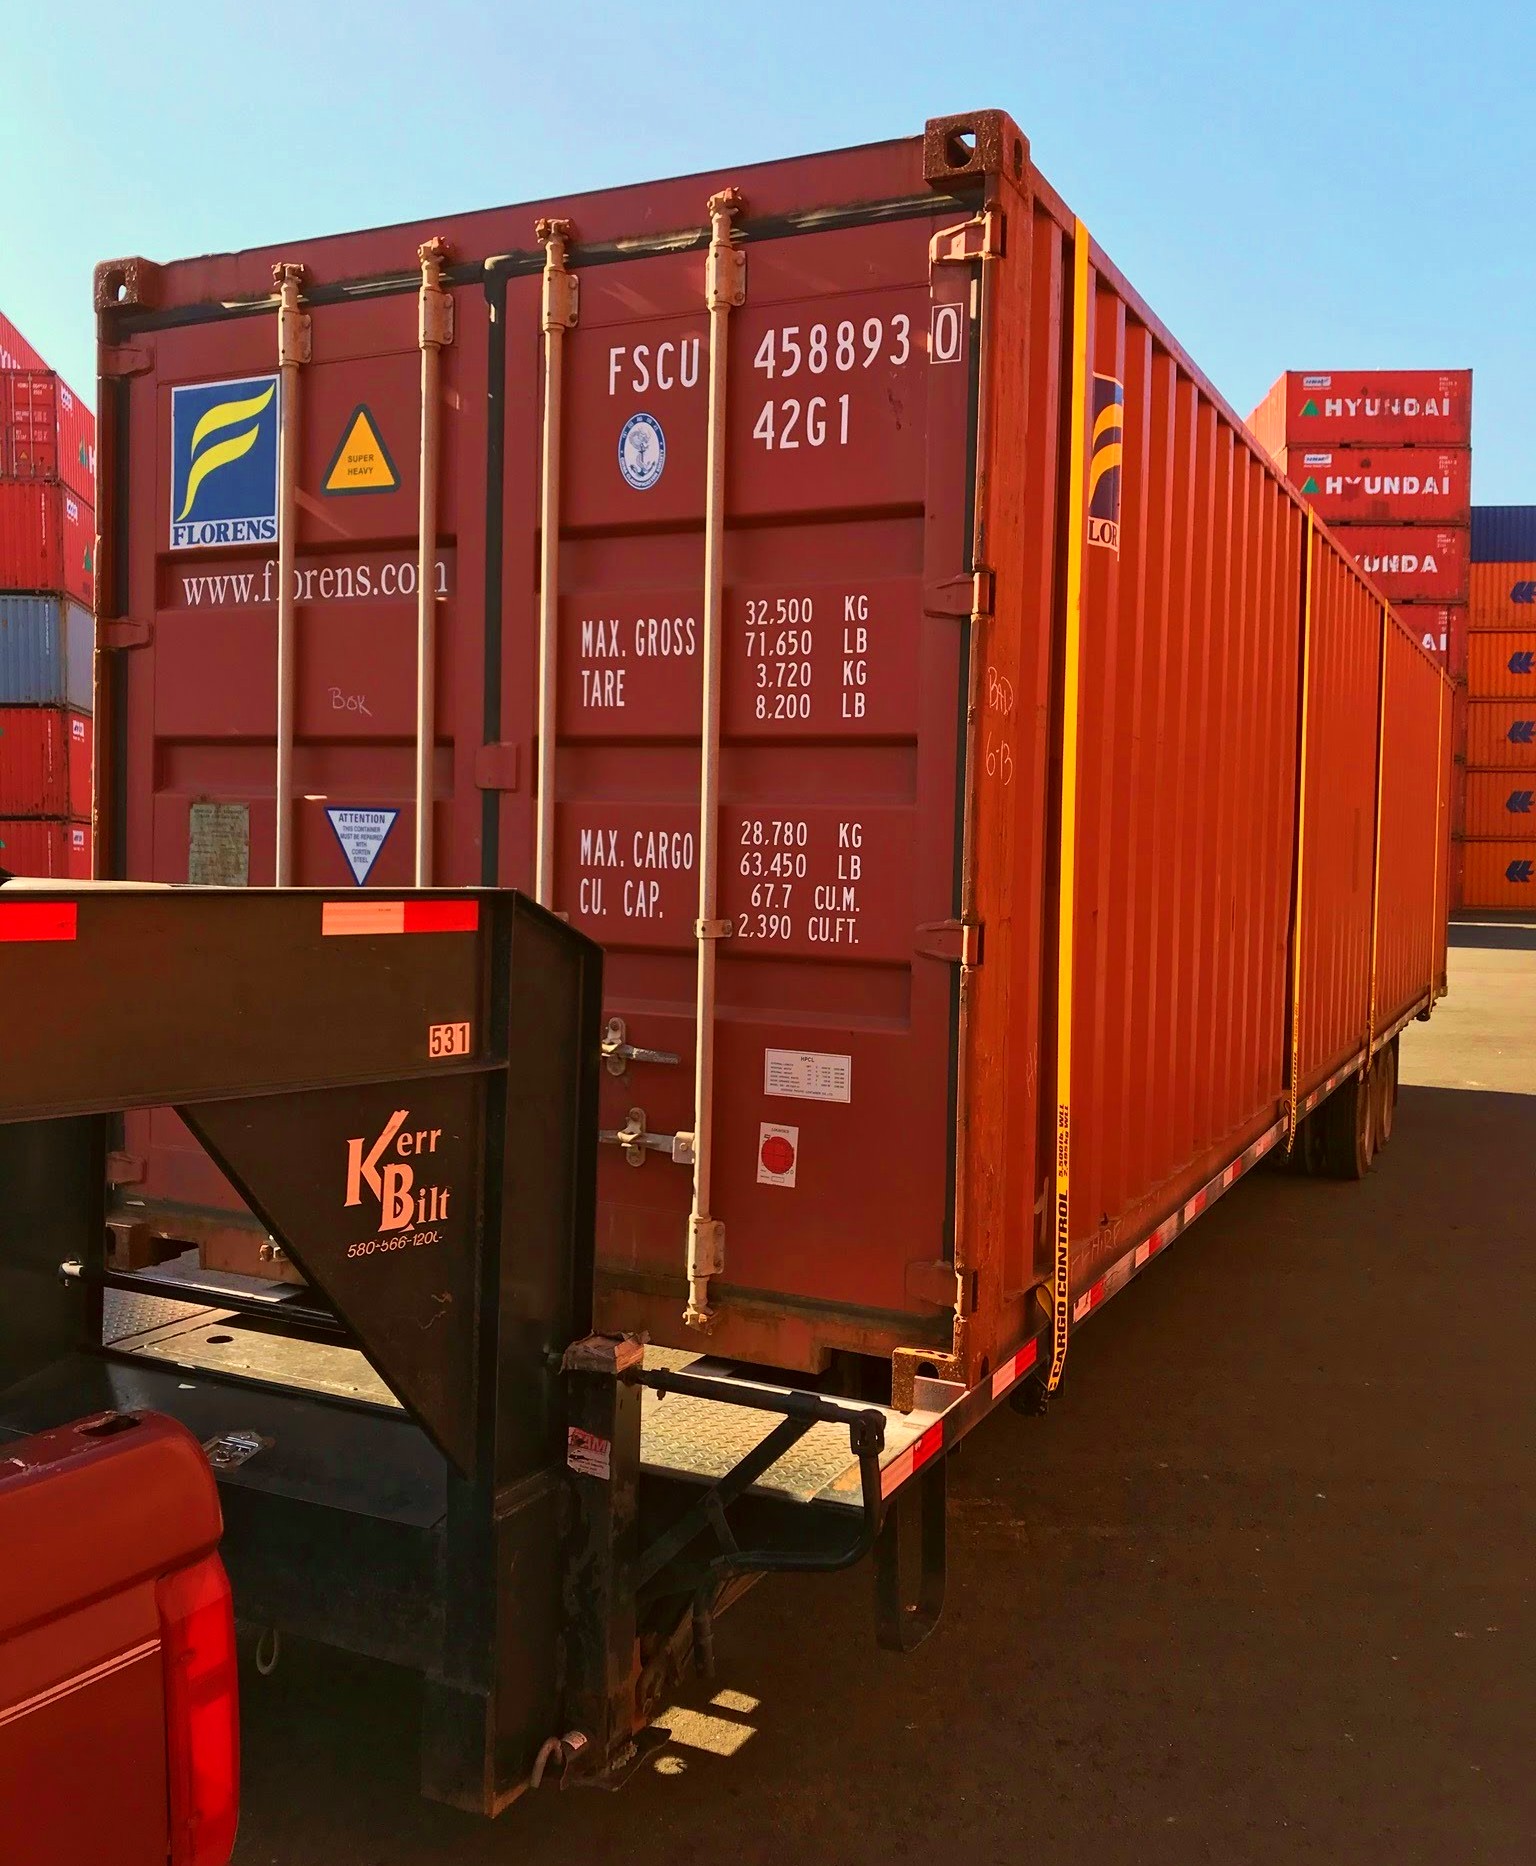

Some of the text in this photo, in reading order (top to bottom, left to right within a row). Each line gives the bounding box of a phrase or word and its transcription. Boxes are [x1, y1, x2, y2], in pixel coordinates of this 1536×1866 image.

[608, 306, 959, 396] FSCU 458893 0
[753, 393, 850, 451] 42G1
[1325, 398, 1450, 416] HYUNDAI
[347, 454, 375, 463] SUPER
[347, 467, 374, 476] HEAVY
[172, 518, 276, 546] FLORENS
[745, 595, 869, 626] 32,500 KG
[581, 617, 696, 658] MAX. GROSS
[745, 627, 868, 657] 71,650 LB
[581, 669, 626, 708] TARE
[756, 660, 867, 688] 3,720 KG
[755, 692, 866, 719] 8,200 LB
[338, 813, 386, 824] ATTENTION
[740, 820, 863, 848] 28,780 KG
[580, 829, 694, 870] MAX. CARGO
[740, 852, 862, 881] 63,450 LB
[580, 878, 663, 919] CU. CAP.
[751, 883, 861, 913] 67.7 CU.M.
[738, 913, 860, 944] 2,390 CU.FT.
[431, 1024, 467, 1055] 531
[343, 1109, 442, 1207] Kerr
[378, 1163, 450, 1232] Bilt
[1056, 1190, 1068, 1299] CONTROL
[1052, 1301, 1068, 1378] CARGO
